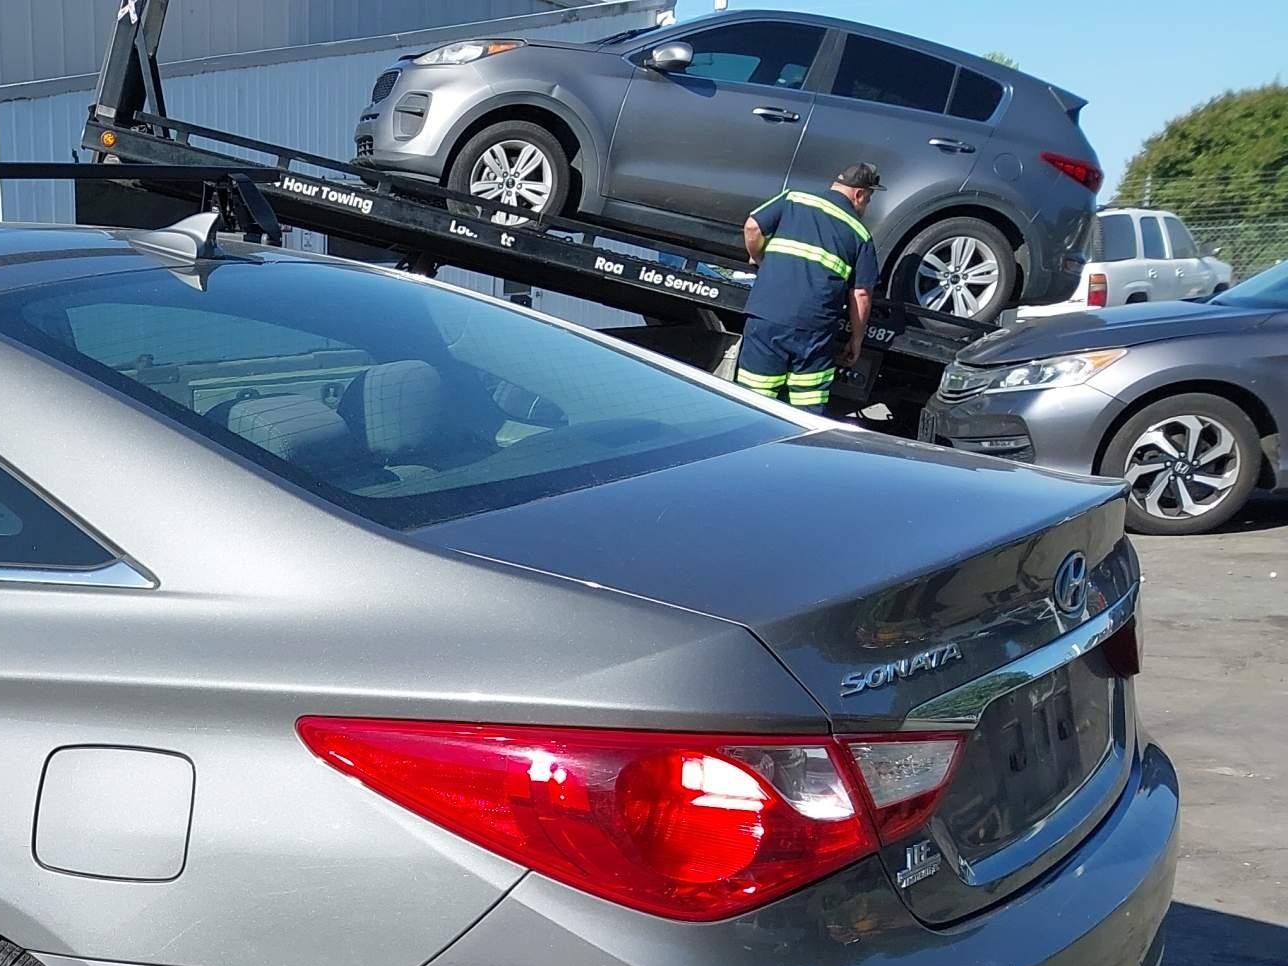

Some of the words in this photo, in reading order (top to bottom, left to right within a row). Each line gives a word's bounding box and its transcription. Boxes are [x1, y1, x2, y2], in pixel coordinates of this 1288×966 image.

[283, 177, 319, 197] Hour
[321, 186, 373, 214] Towing
[664, 274, 720, 298] Service
[840, 642, 962, 697] SONATA
